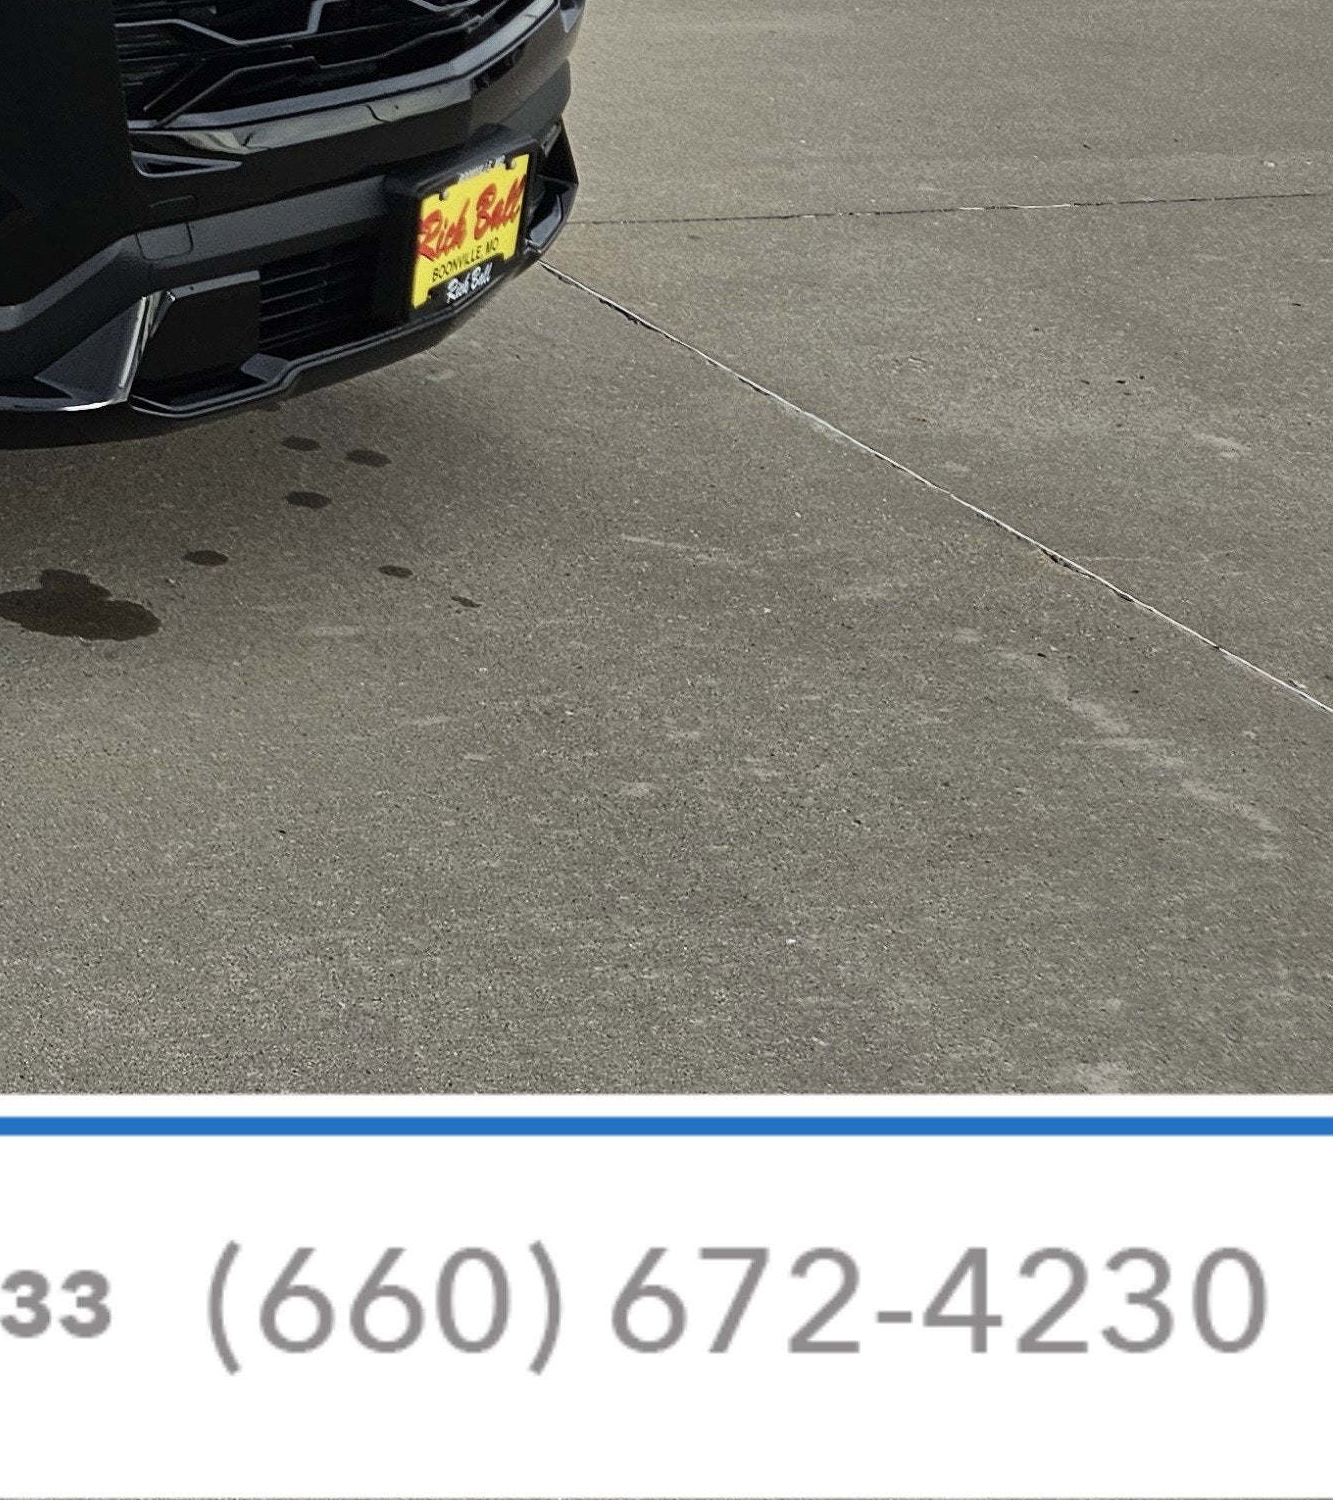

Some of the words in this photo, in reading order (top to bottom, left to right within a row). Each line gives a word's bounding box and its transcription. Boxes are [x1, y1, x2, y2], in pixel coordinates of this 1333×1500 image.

[417, 197, 471, 262] Rick
[474, 173, 527, 241] Ball
[486, 236, 500, 256] MO
